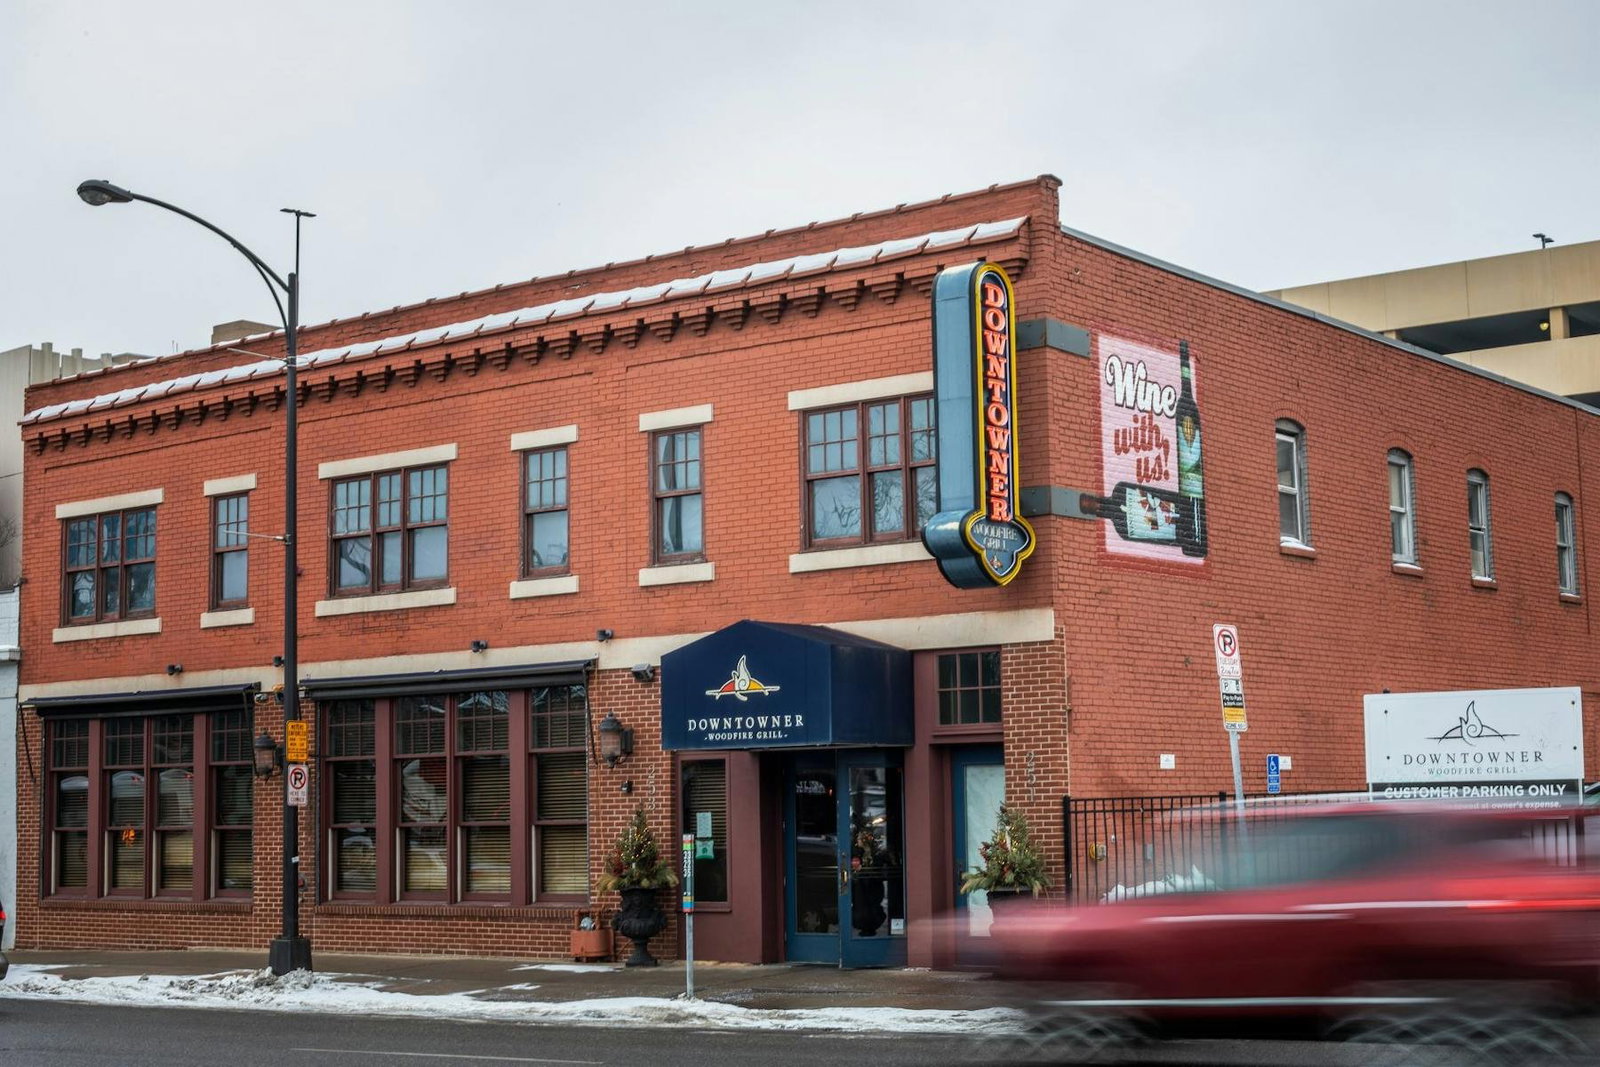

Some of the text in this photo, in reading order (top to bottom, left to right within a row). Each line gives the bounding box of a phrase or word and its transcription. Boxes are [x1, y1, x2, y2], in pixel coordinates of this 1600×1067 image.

[1104, 354, 1178, 419] Wine
[984, 283, 1012, 522] DOWNTOWNER
[1113, 411, 1164, 456] with
[973, 523, 1018, 541] WOODFIRE
[688, 715, 804, 731] DOWNTOWNER
[1403, 751, 1544, 766] DOWNTOWNER
[648, 764, 656, 811] 253
[1384, 784, 1567, 799] CUSTOMER PARKING ONLY
[1491, 801, 1523, 809] owner's
[1525, 801, 1562, 810] expense.
